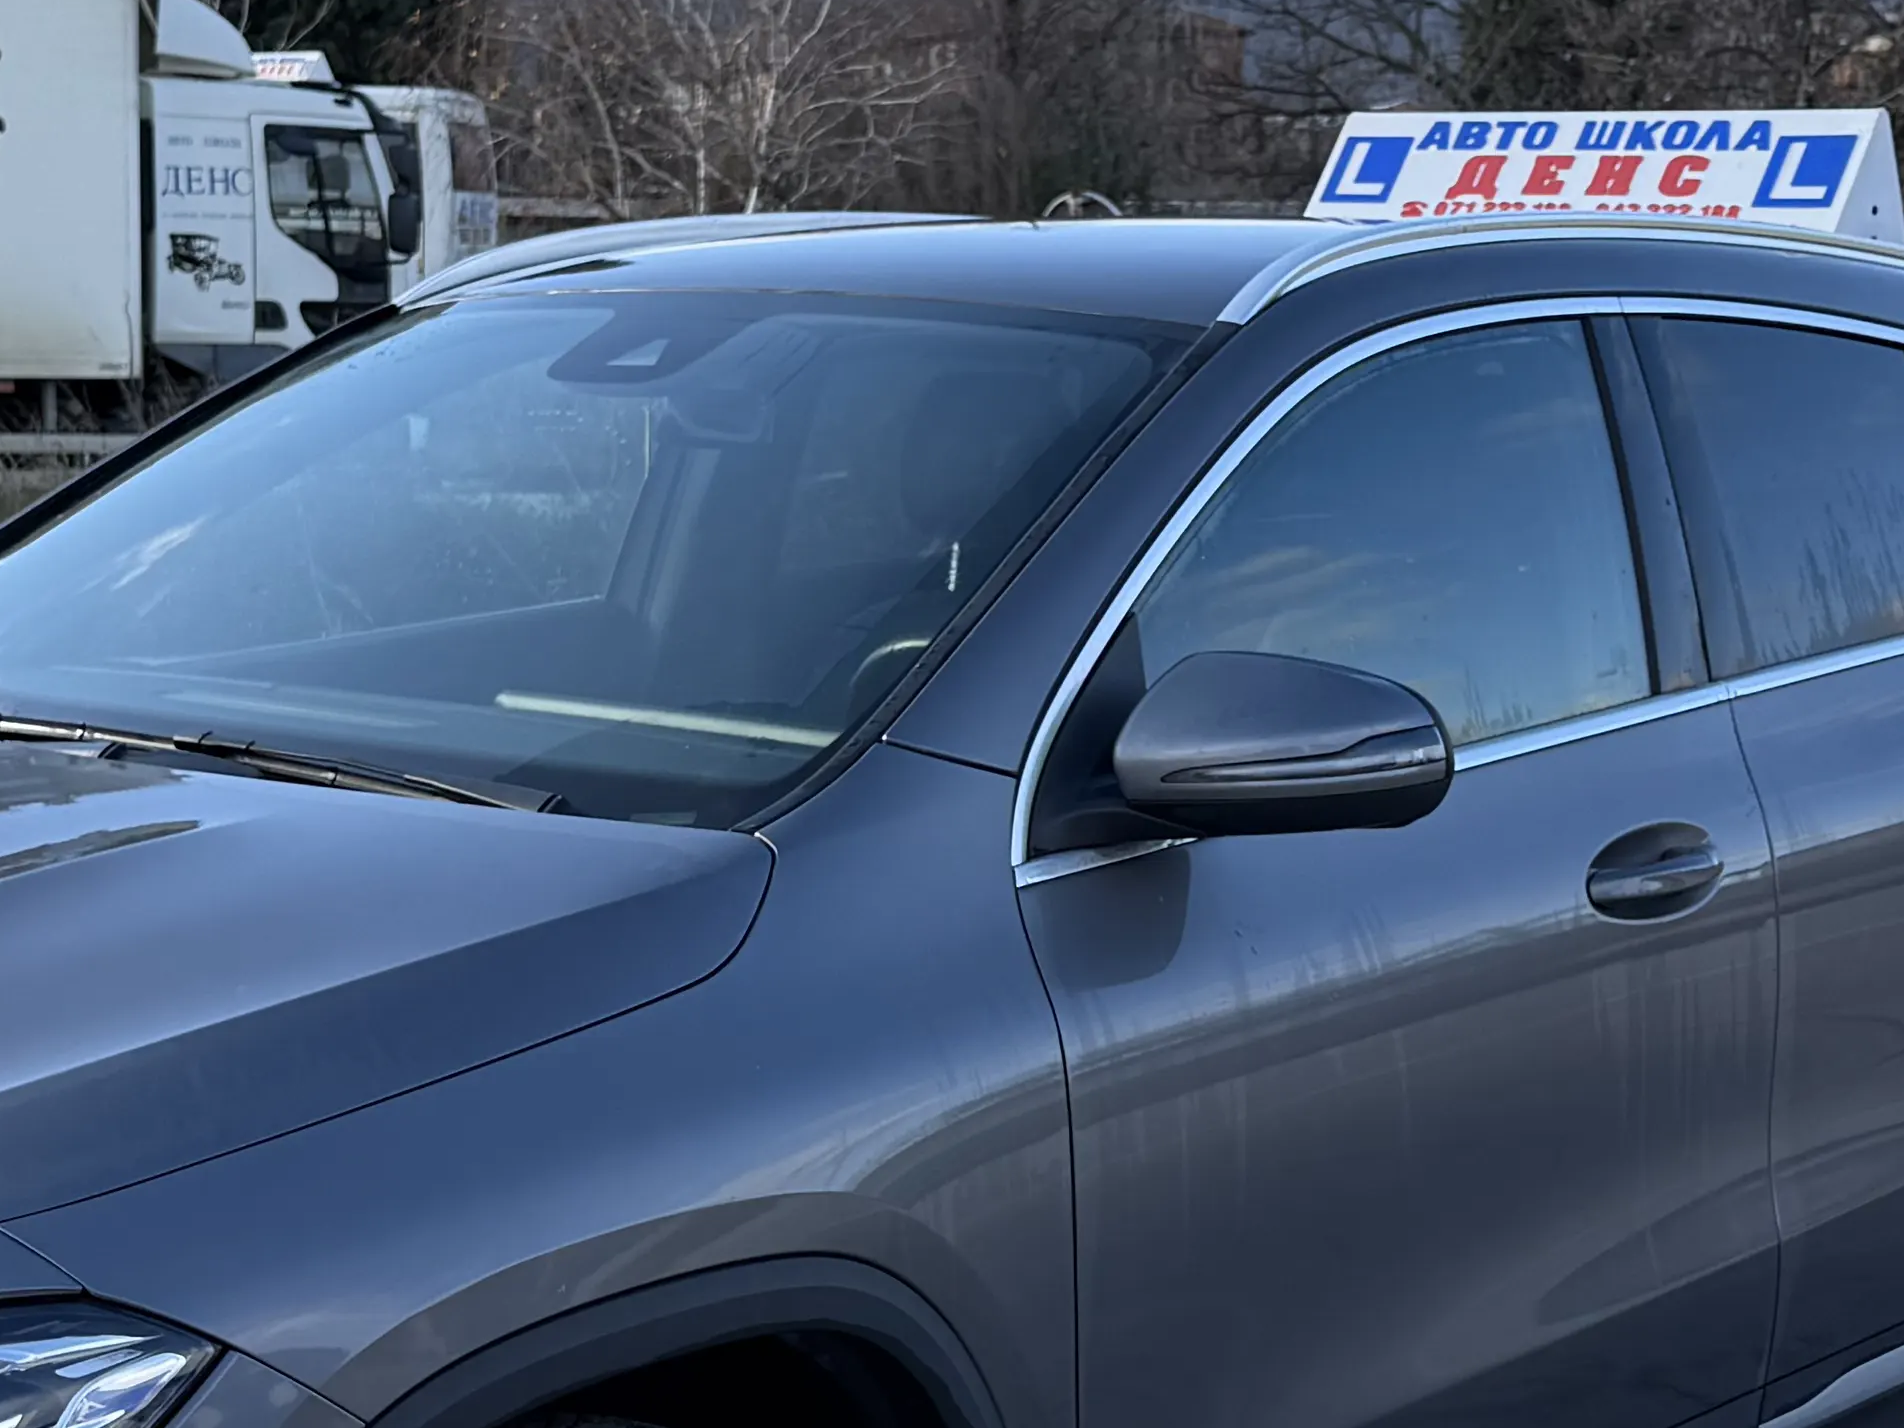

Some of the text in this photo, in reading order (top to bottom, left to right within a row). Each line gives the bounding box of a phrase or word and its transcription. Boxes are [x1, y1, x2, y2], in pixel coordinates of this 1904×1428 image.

[1416, 120, 1772, 152] АВТО ШКОЛА
[162, 164, 254, 199] ДЕНС
[1445, 155, 1712, 200] ДЕНС
